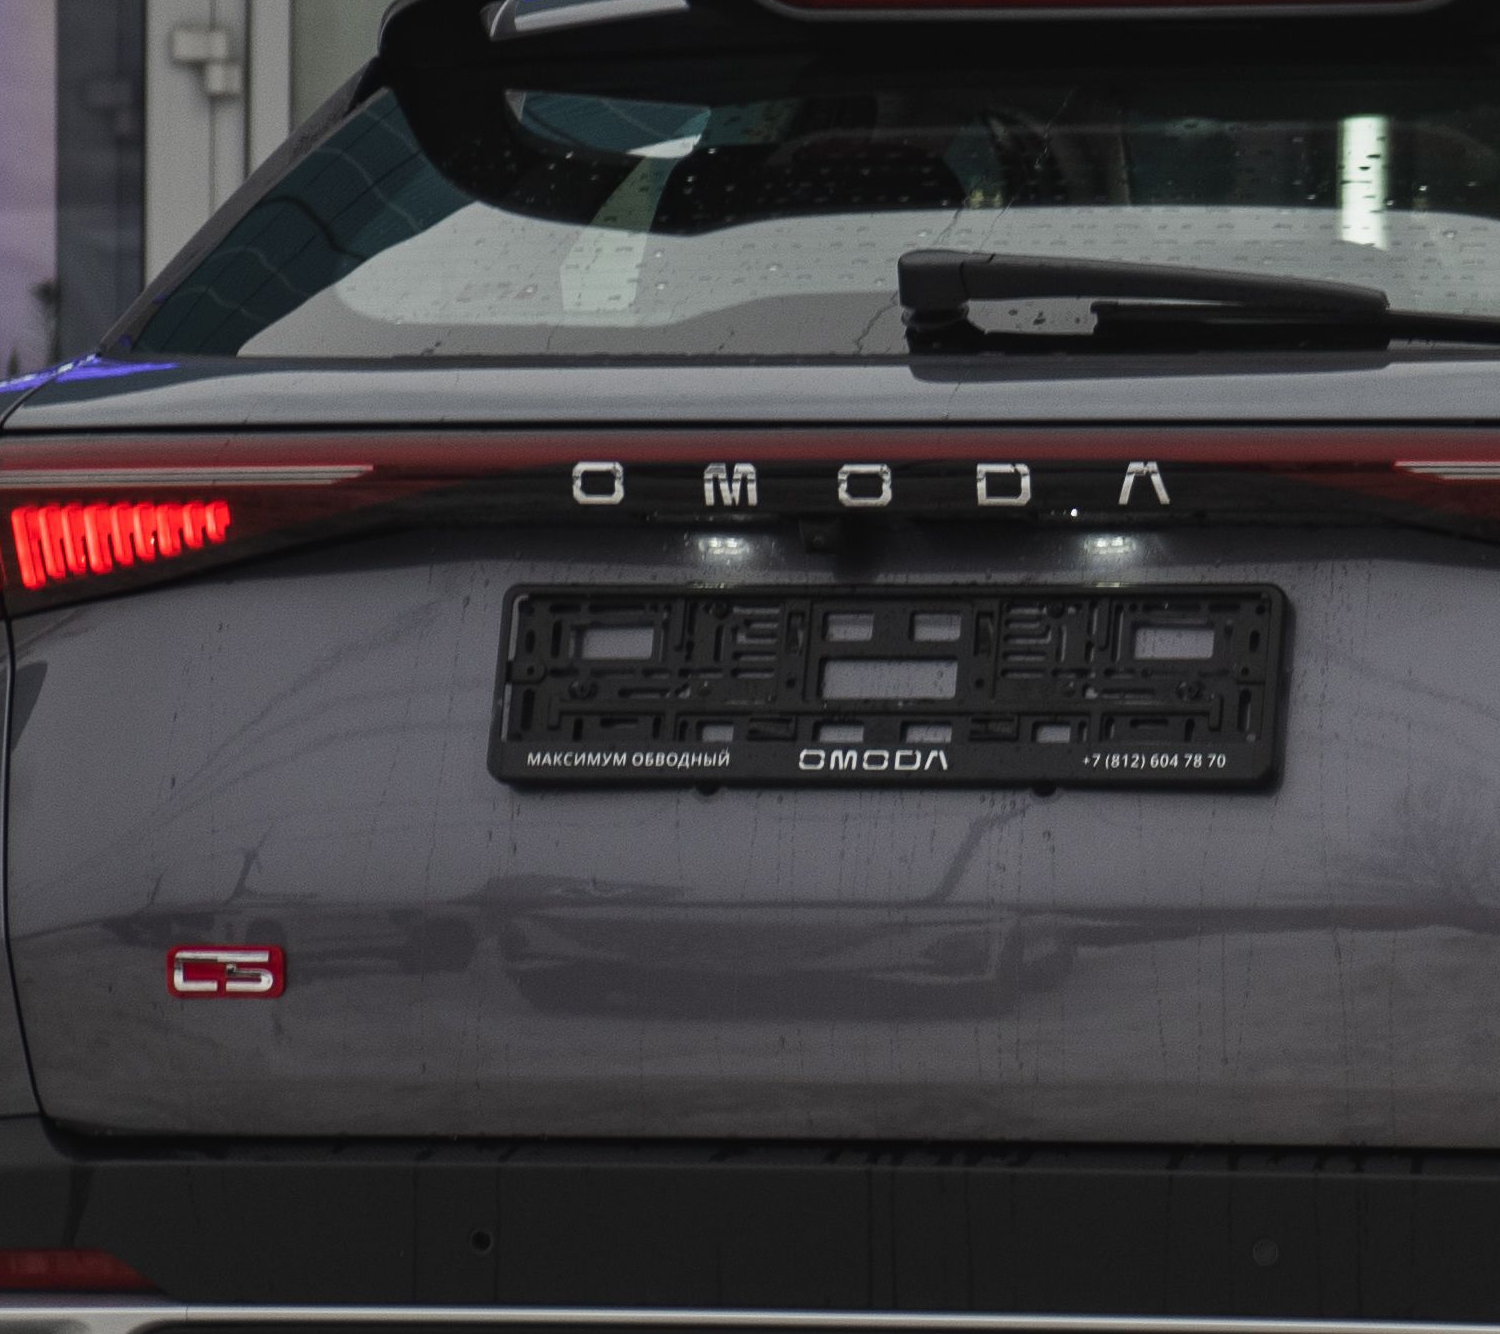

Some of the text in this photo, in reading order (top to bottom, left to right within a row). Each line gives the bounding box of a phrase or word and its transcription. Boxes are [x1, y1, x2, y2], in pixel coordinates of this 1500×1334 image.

[572, 461, 1171, 506] OMODA
[526, 747, 731, 769] МАКСИМУМ ОБВОДНЫЙ
[798, 749, 949, 771] OMODA
[1083, 753, 1227, 770] +7 (812) 604 78 70
[173, 950, 274, 992] C5
